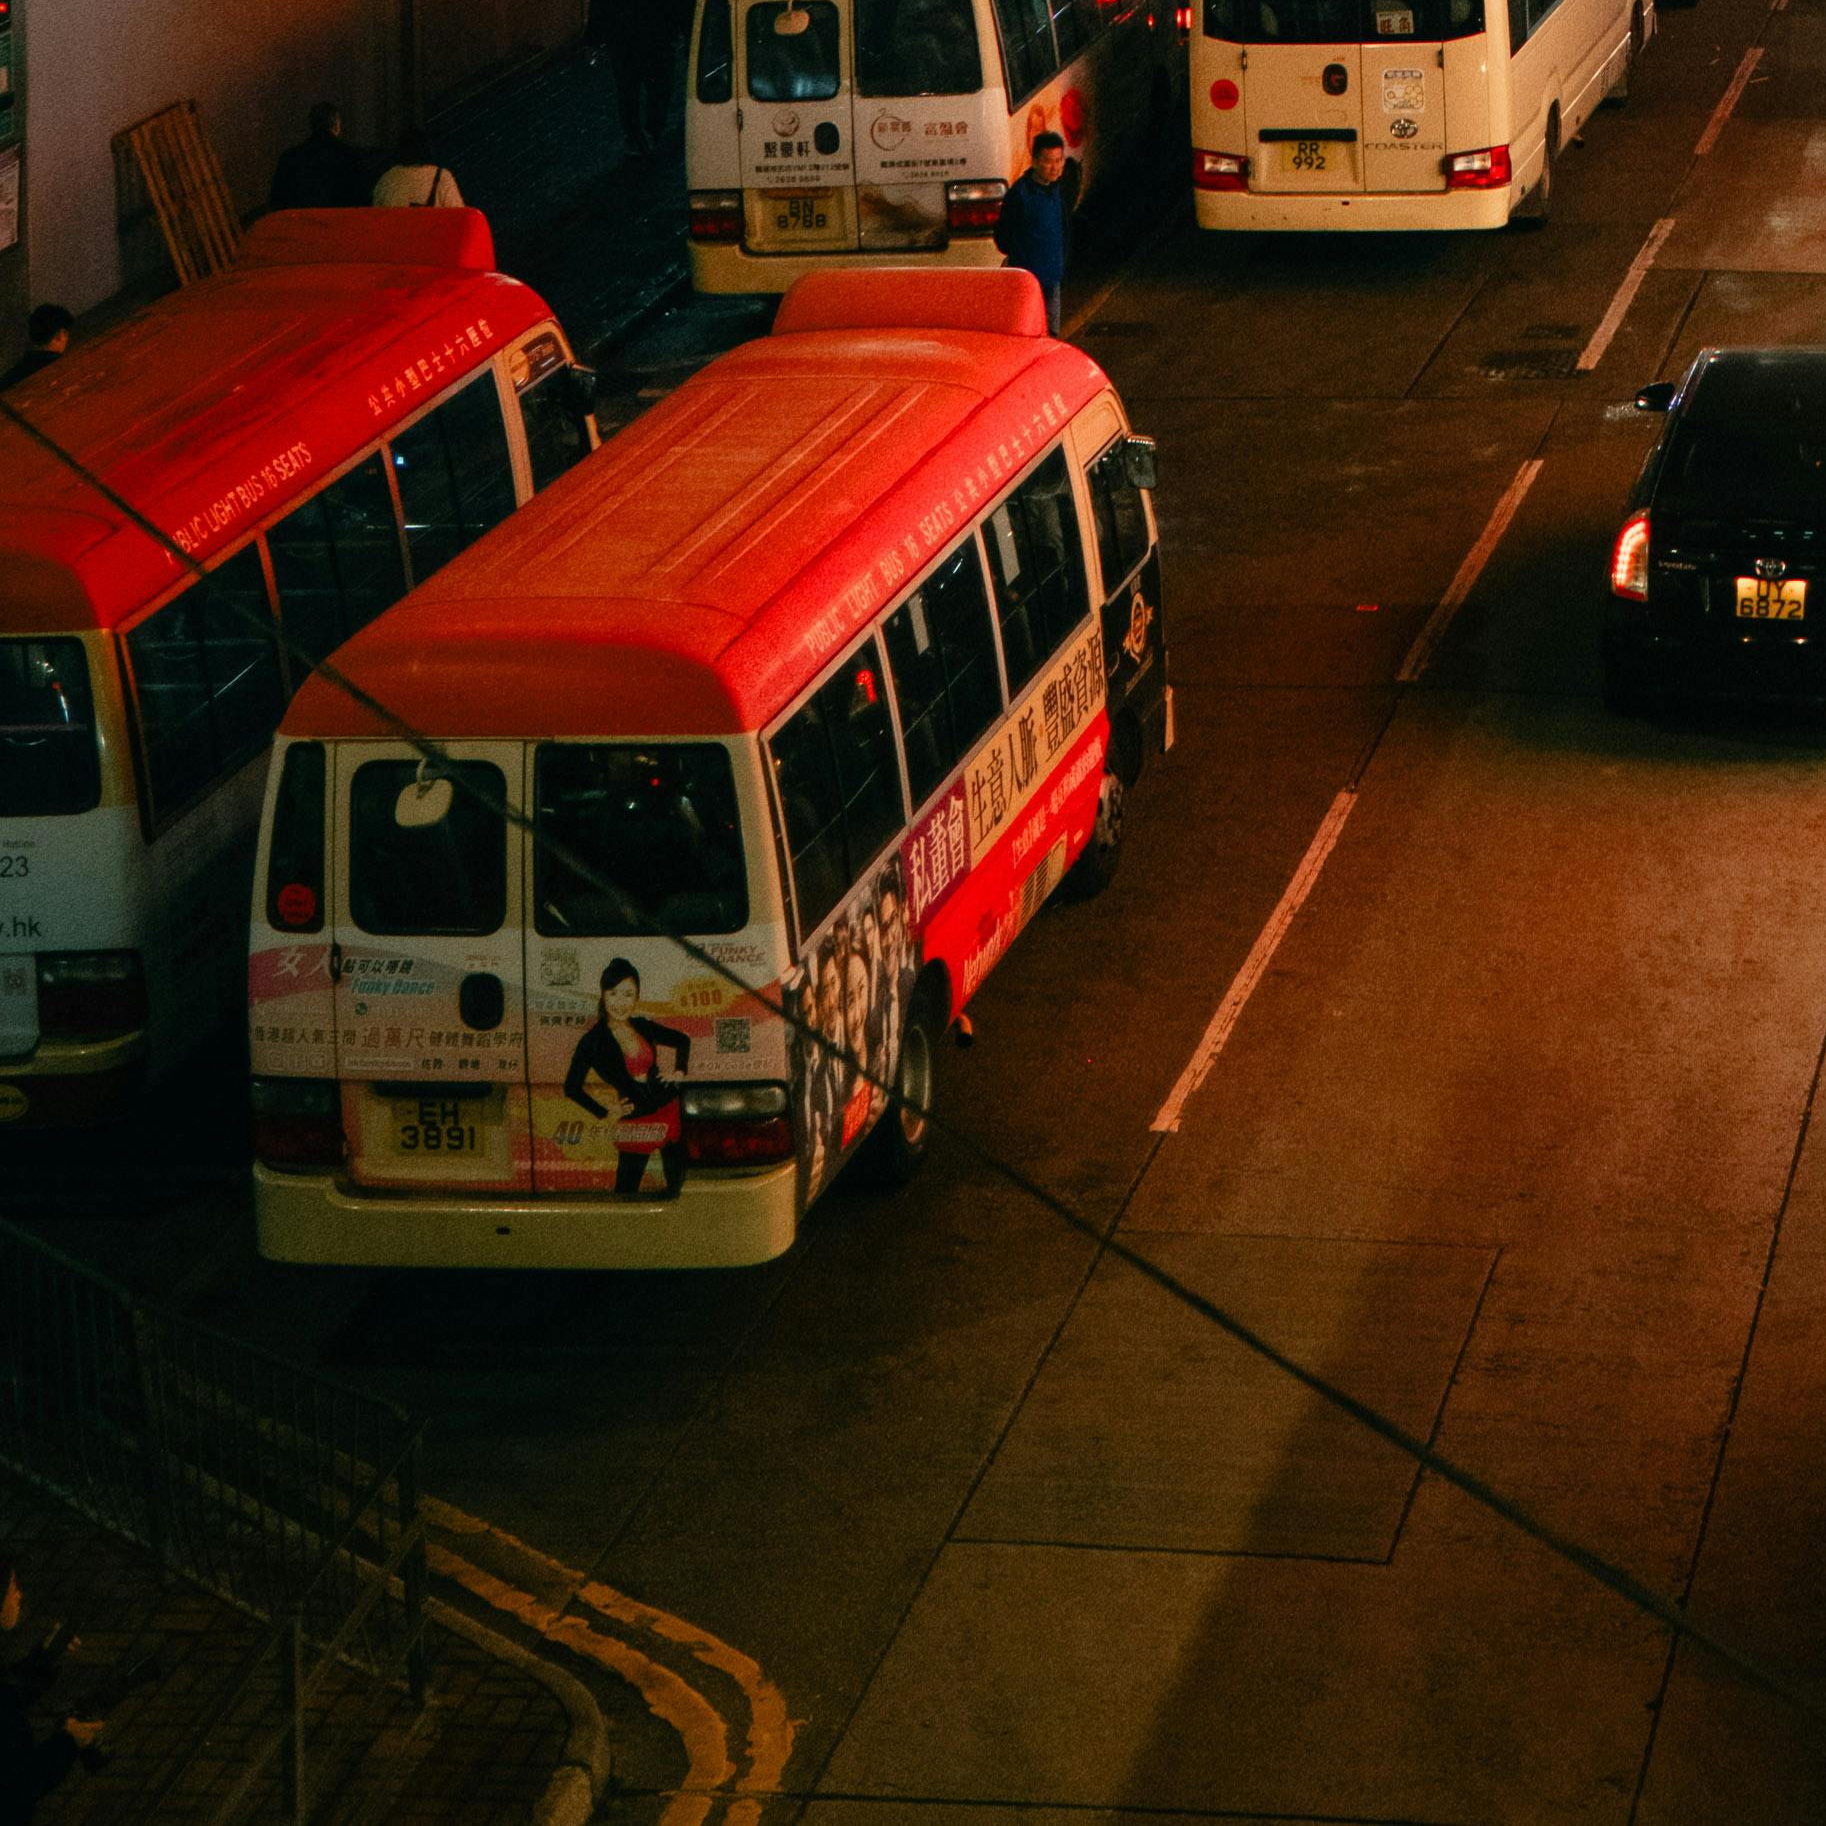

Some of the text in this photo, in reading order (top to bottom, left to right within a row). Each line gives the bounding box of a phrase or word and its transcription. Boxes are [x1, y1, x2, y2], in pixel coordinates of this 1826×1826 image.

[1297, 142, 1320, 156] RR
[1292, 155, 1326, 171] 992
[202, 491, 244, 534] LIGHT
[235, 474, 267, 511] BUS
[272, 441, 313, 482] SEATS
[803, 609, 846, 659] PUBLIC
[846, 572, 880, 620] LIGHT
[879, 550, 905, 589] BUS
[919, 502, 956, 547] SEATS
[1740, 599, 1802, 619] 6872
[909, 795, 965, 925] 私董會
[419, 1100, 460, 1125] EH
[401, 1126, 476, 1151] 3891
